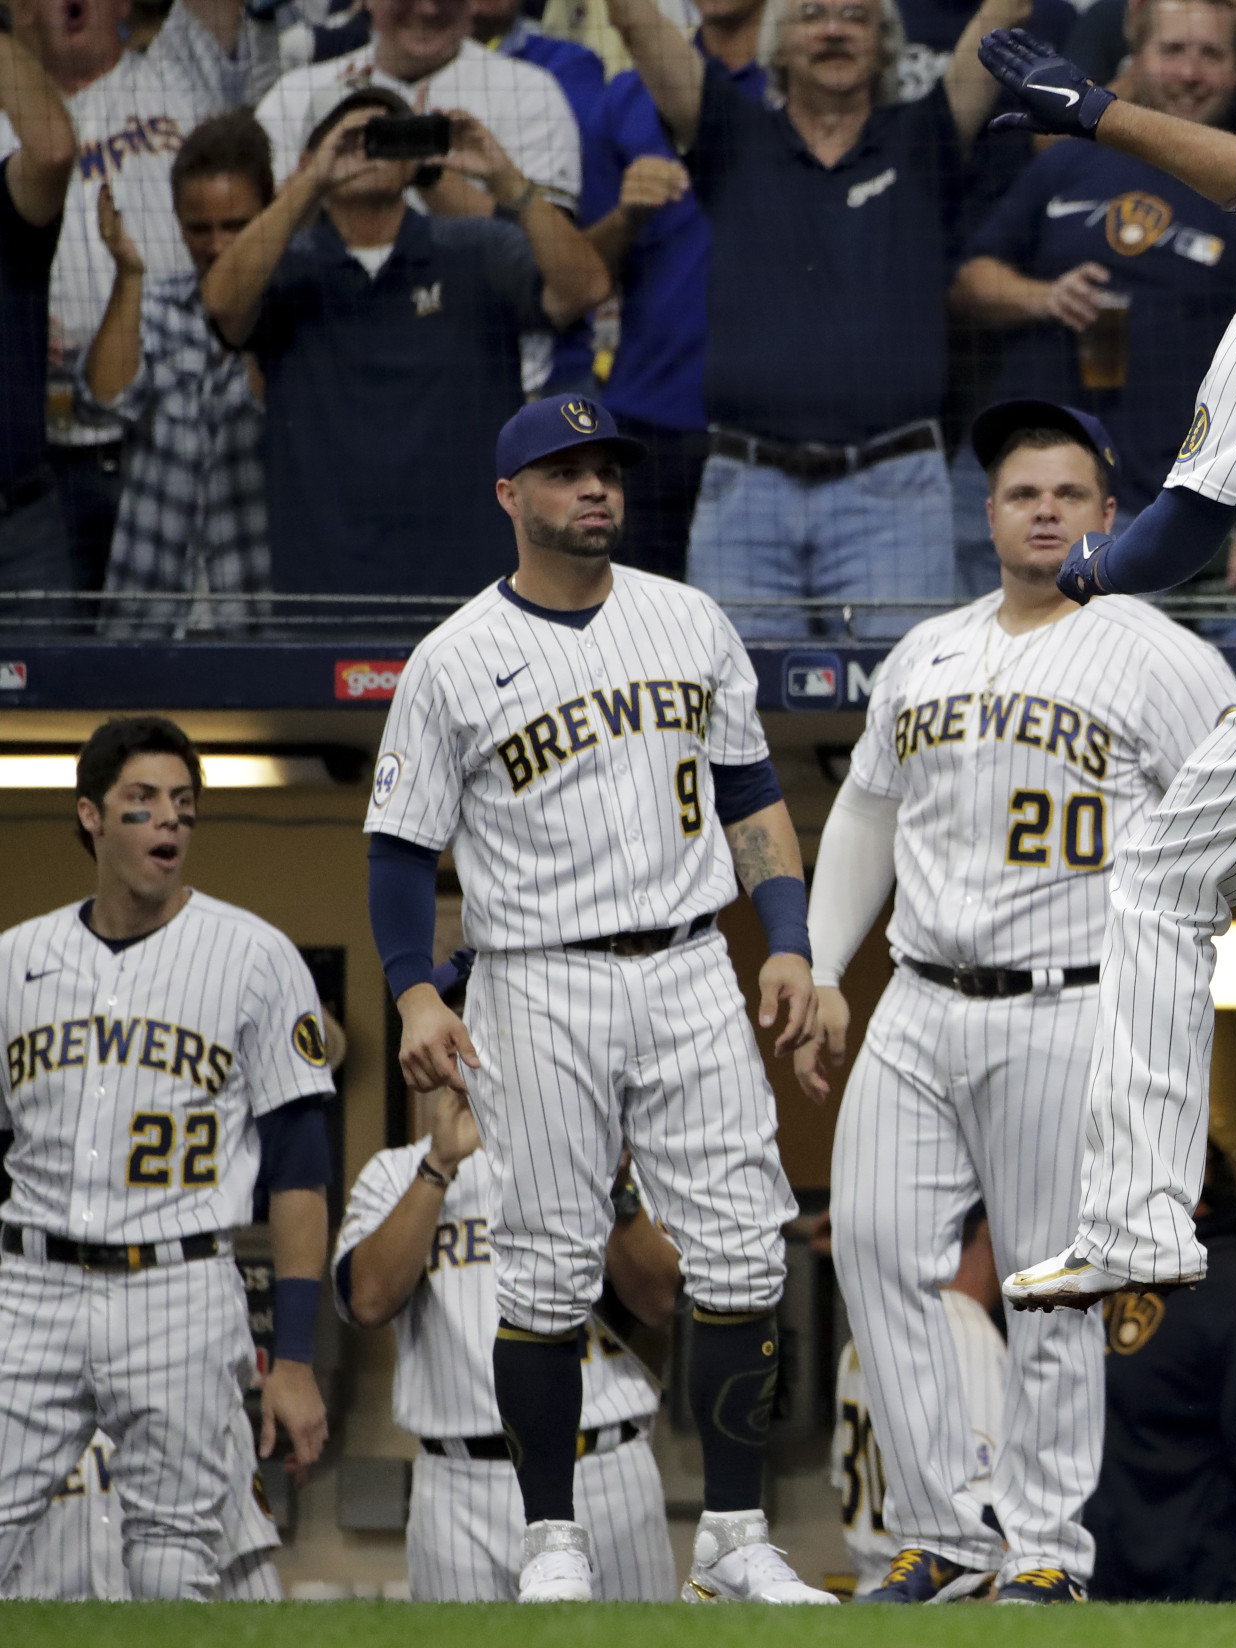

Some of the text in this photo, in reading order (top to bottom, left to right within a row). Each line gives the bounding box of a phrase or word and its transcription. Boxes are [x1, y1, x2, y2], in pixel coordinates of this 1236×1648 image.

[347, 671, 400, 697] goo
[895, 692, 1112, 781] BREWERS
[376, 766, 396, 793] 44
[674, 756, 703, 838] 9
[1005, 788, 1107, 870] 20
[7, 1014, 233, 1096] BREWERS
[126, 1111, 219, 1188] 22
